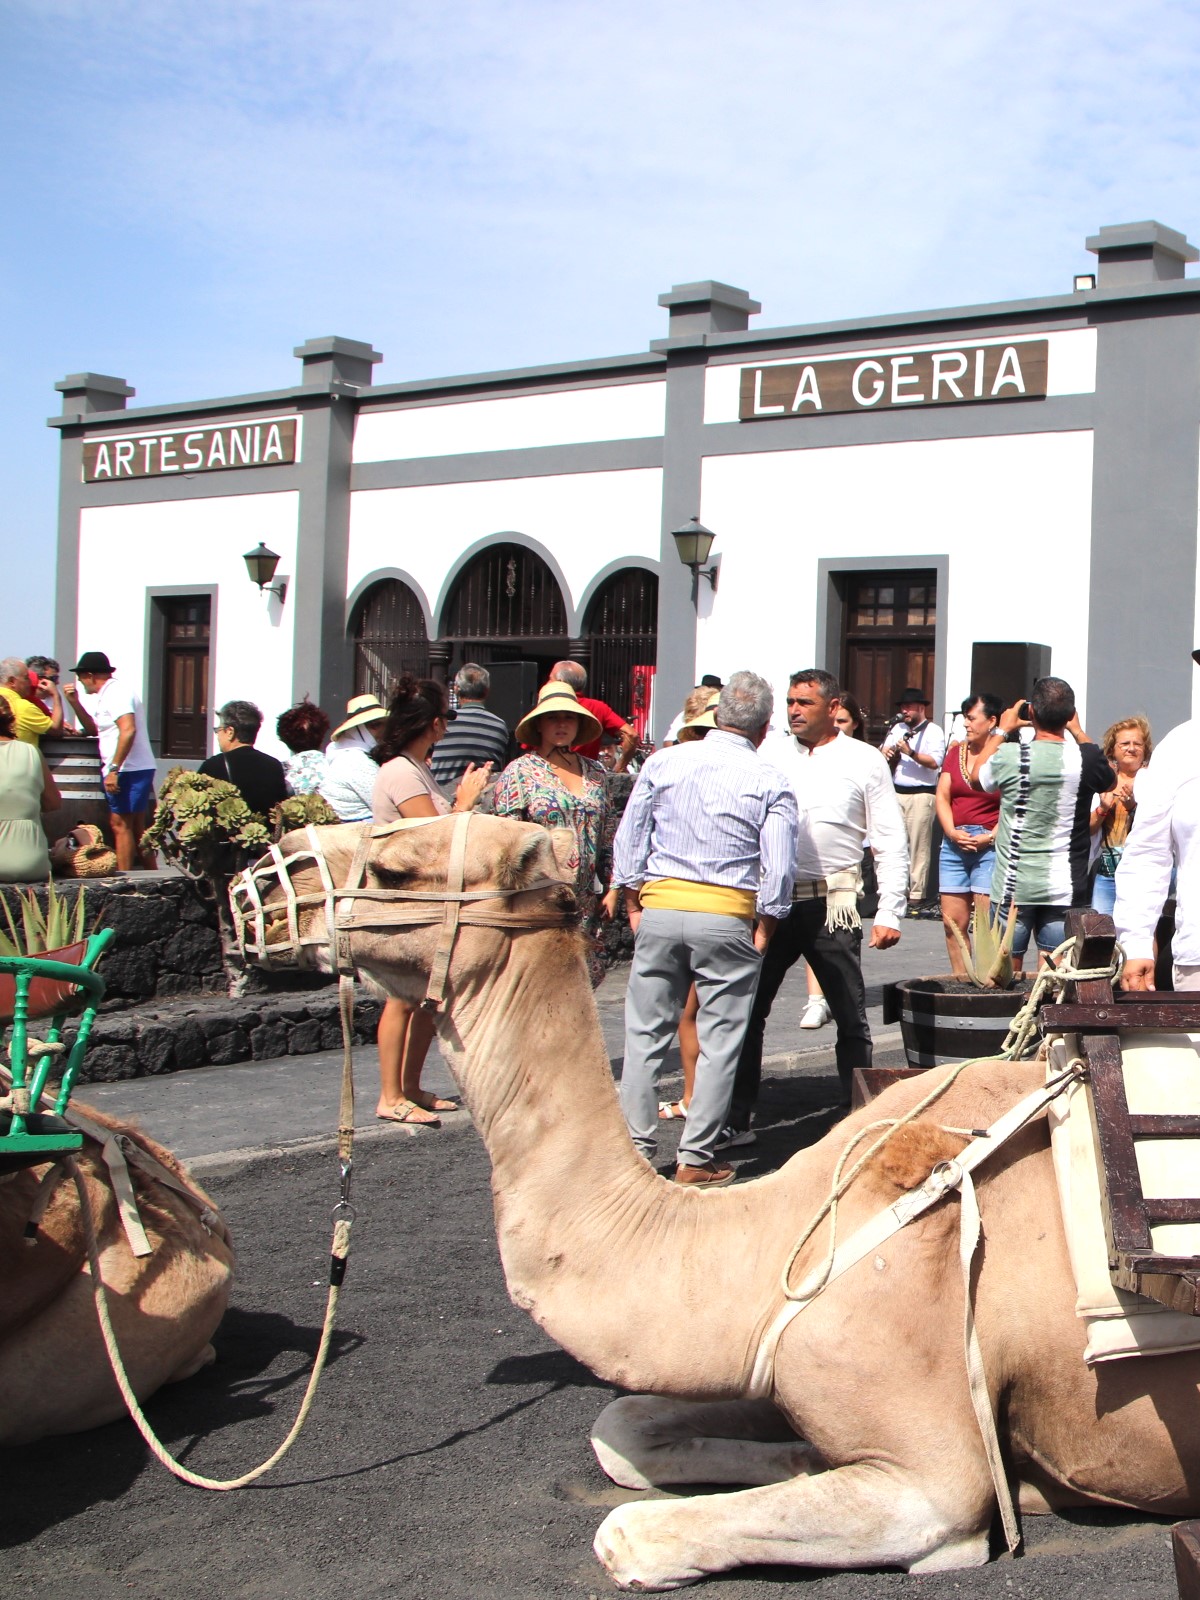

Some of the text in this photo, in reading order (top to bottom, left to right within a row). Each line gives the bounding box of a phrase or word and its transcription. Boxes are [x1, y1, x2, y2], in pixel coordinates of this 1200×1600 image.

[754, 347, 1026, 415] LA GERIA
[93, 424, 284, 479] ARTESANIA
